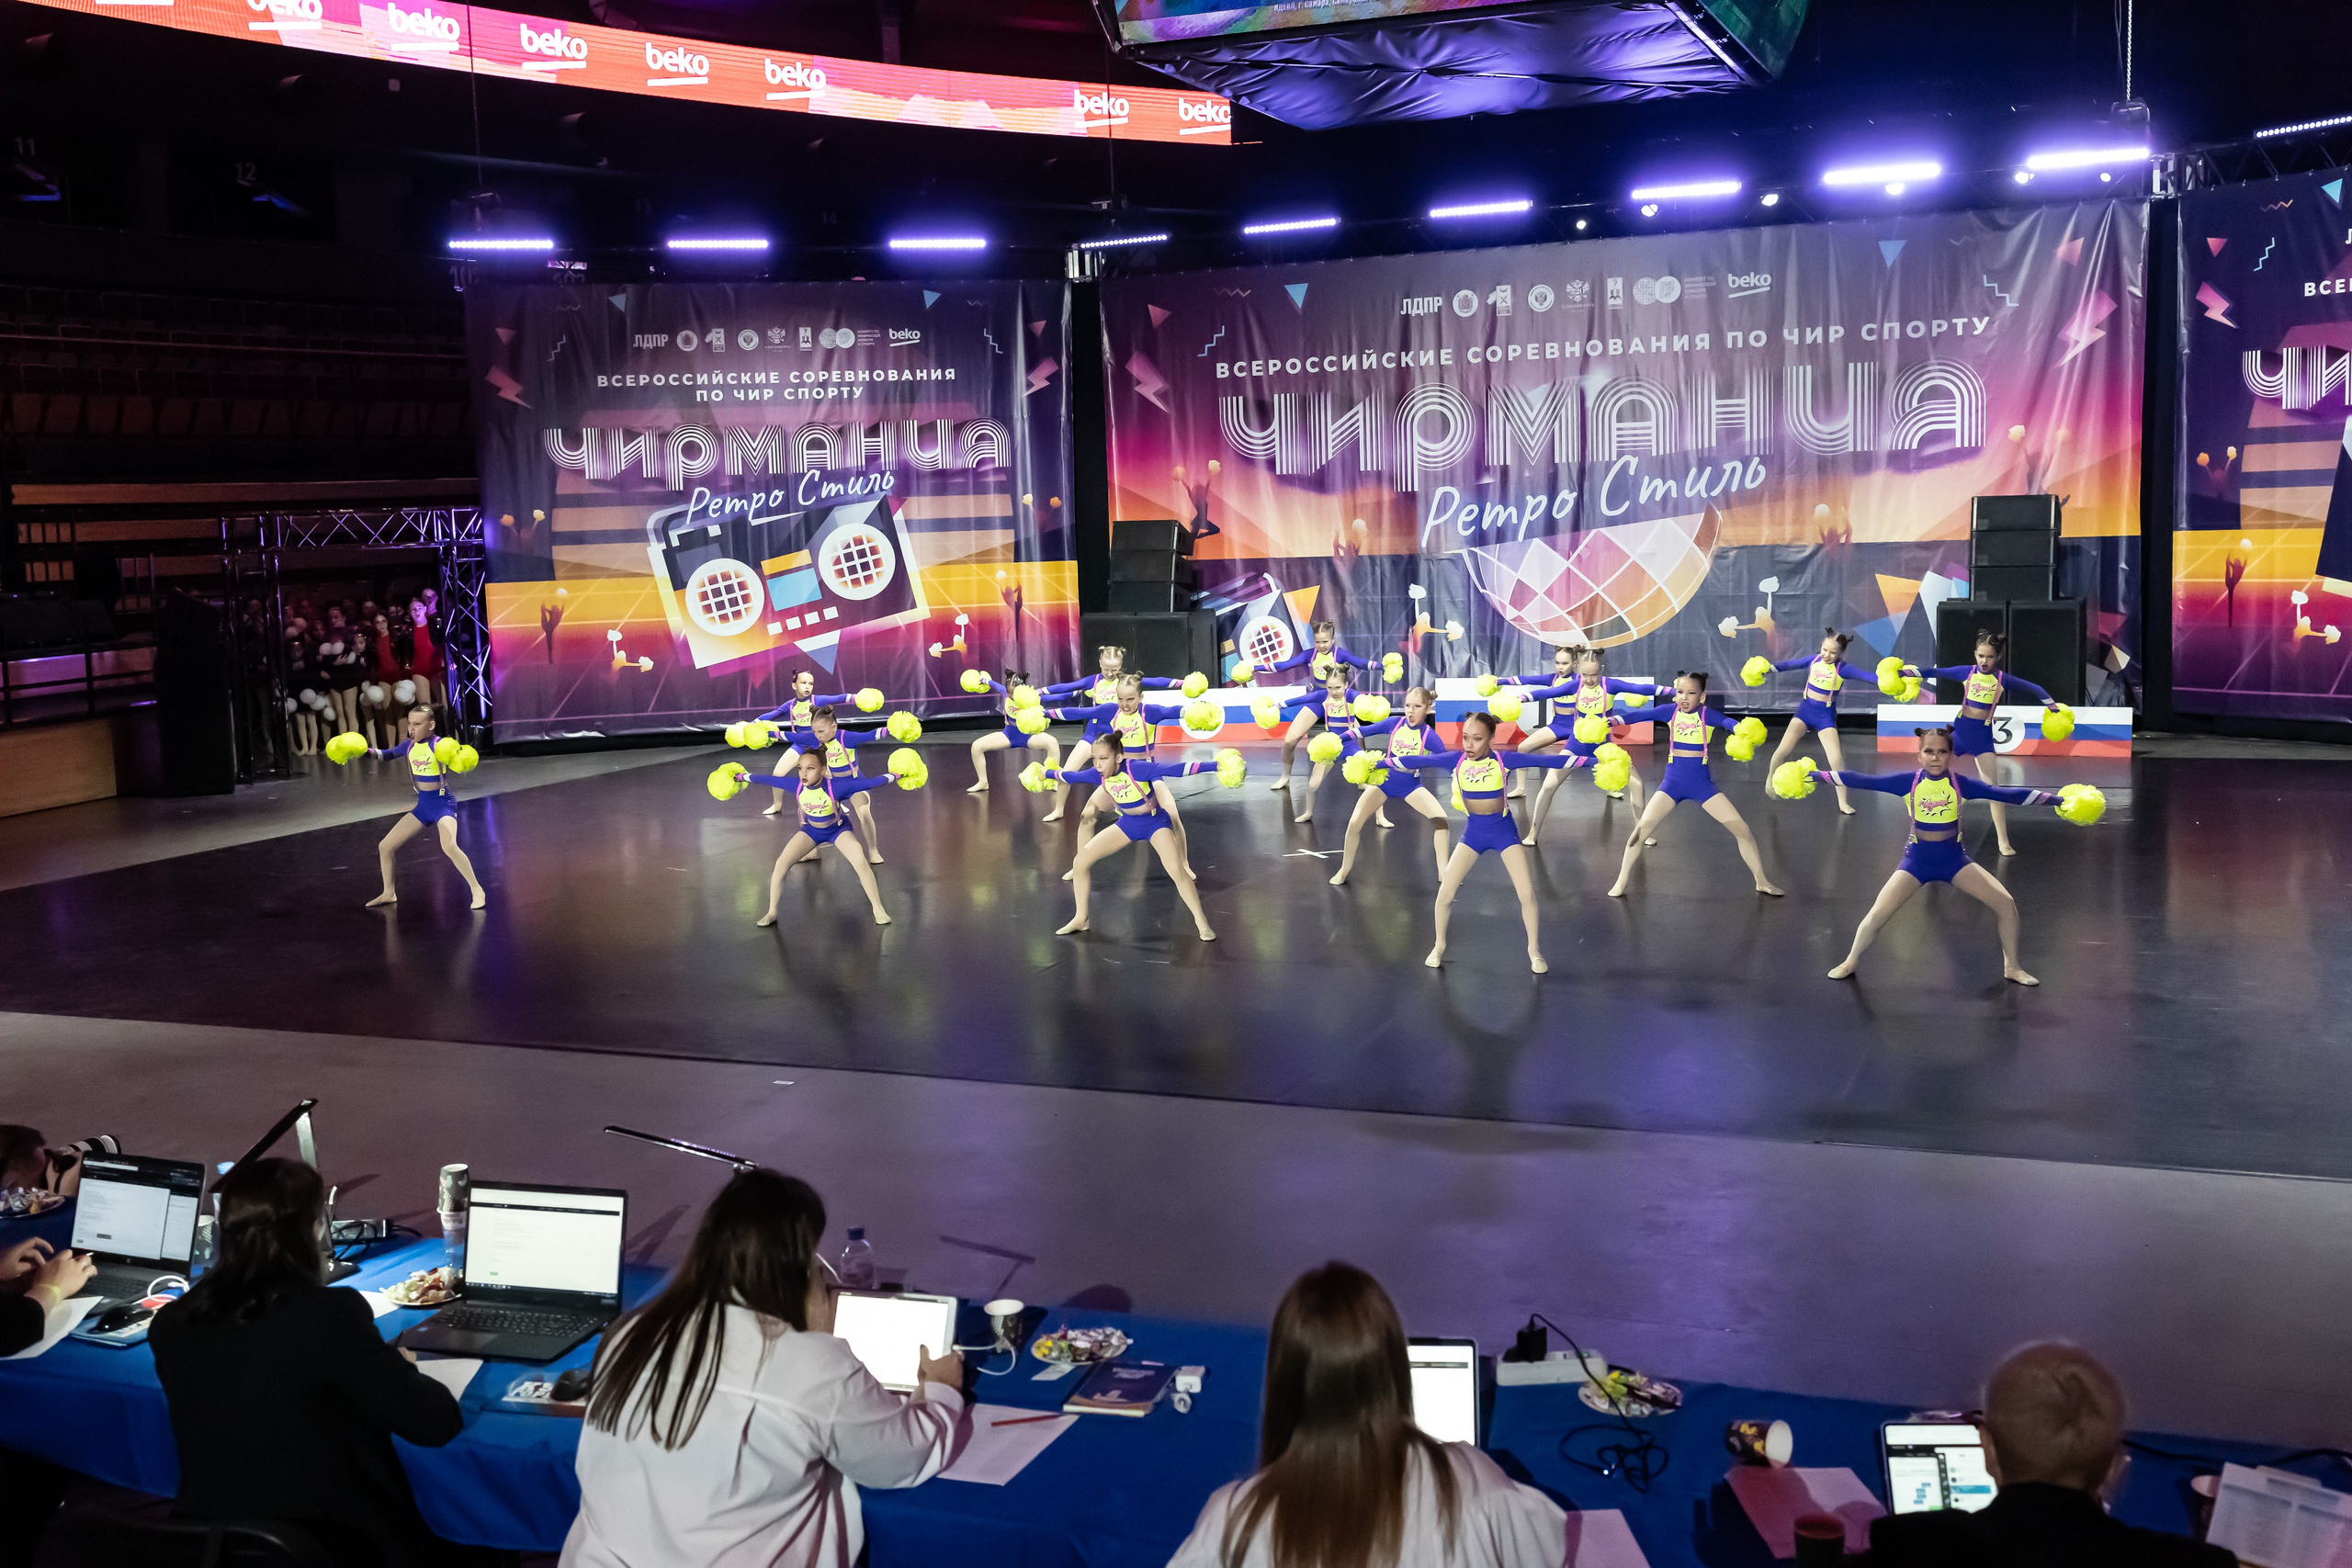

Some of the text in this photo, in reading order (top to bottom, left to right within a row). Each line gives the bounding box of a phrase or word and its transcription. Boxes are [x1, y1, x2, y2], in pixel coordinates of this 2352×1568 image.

[388, 3, 460, 41] beko
[520, 23, 588, 60] beko
[645, 42, 710, 76] beko
[764, 58, 826, 89] beko
[1073, 89, 1130, 117] beko
[1728, 272, 1771, 288] beko
[1400, 296, 1443, 317] ЛДПР
[633, 333, 669, 349] ЛДПР
[888, 328, 921, 340] beko
[1216, 316, 1991, 378] ВСЕРОССИЙСКИЕ СОРЕВНОВАНИЯ ПО ЧИР СПОРТУ
[597, 367, 956, 388] ВСЕРОССИЙСКИЕ СОРЕВНОВАНИЯ
[695, 386, 864, 402] ПО ЧИР СПОРТУ
[686, 468, 895, 525] Ретро Стиль
[1421, 454, 1767, 548] Ретро Стиль
[1992, 716, 2013, 744] 3
